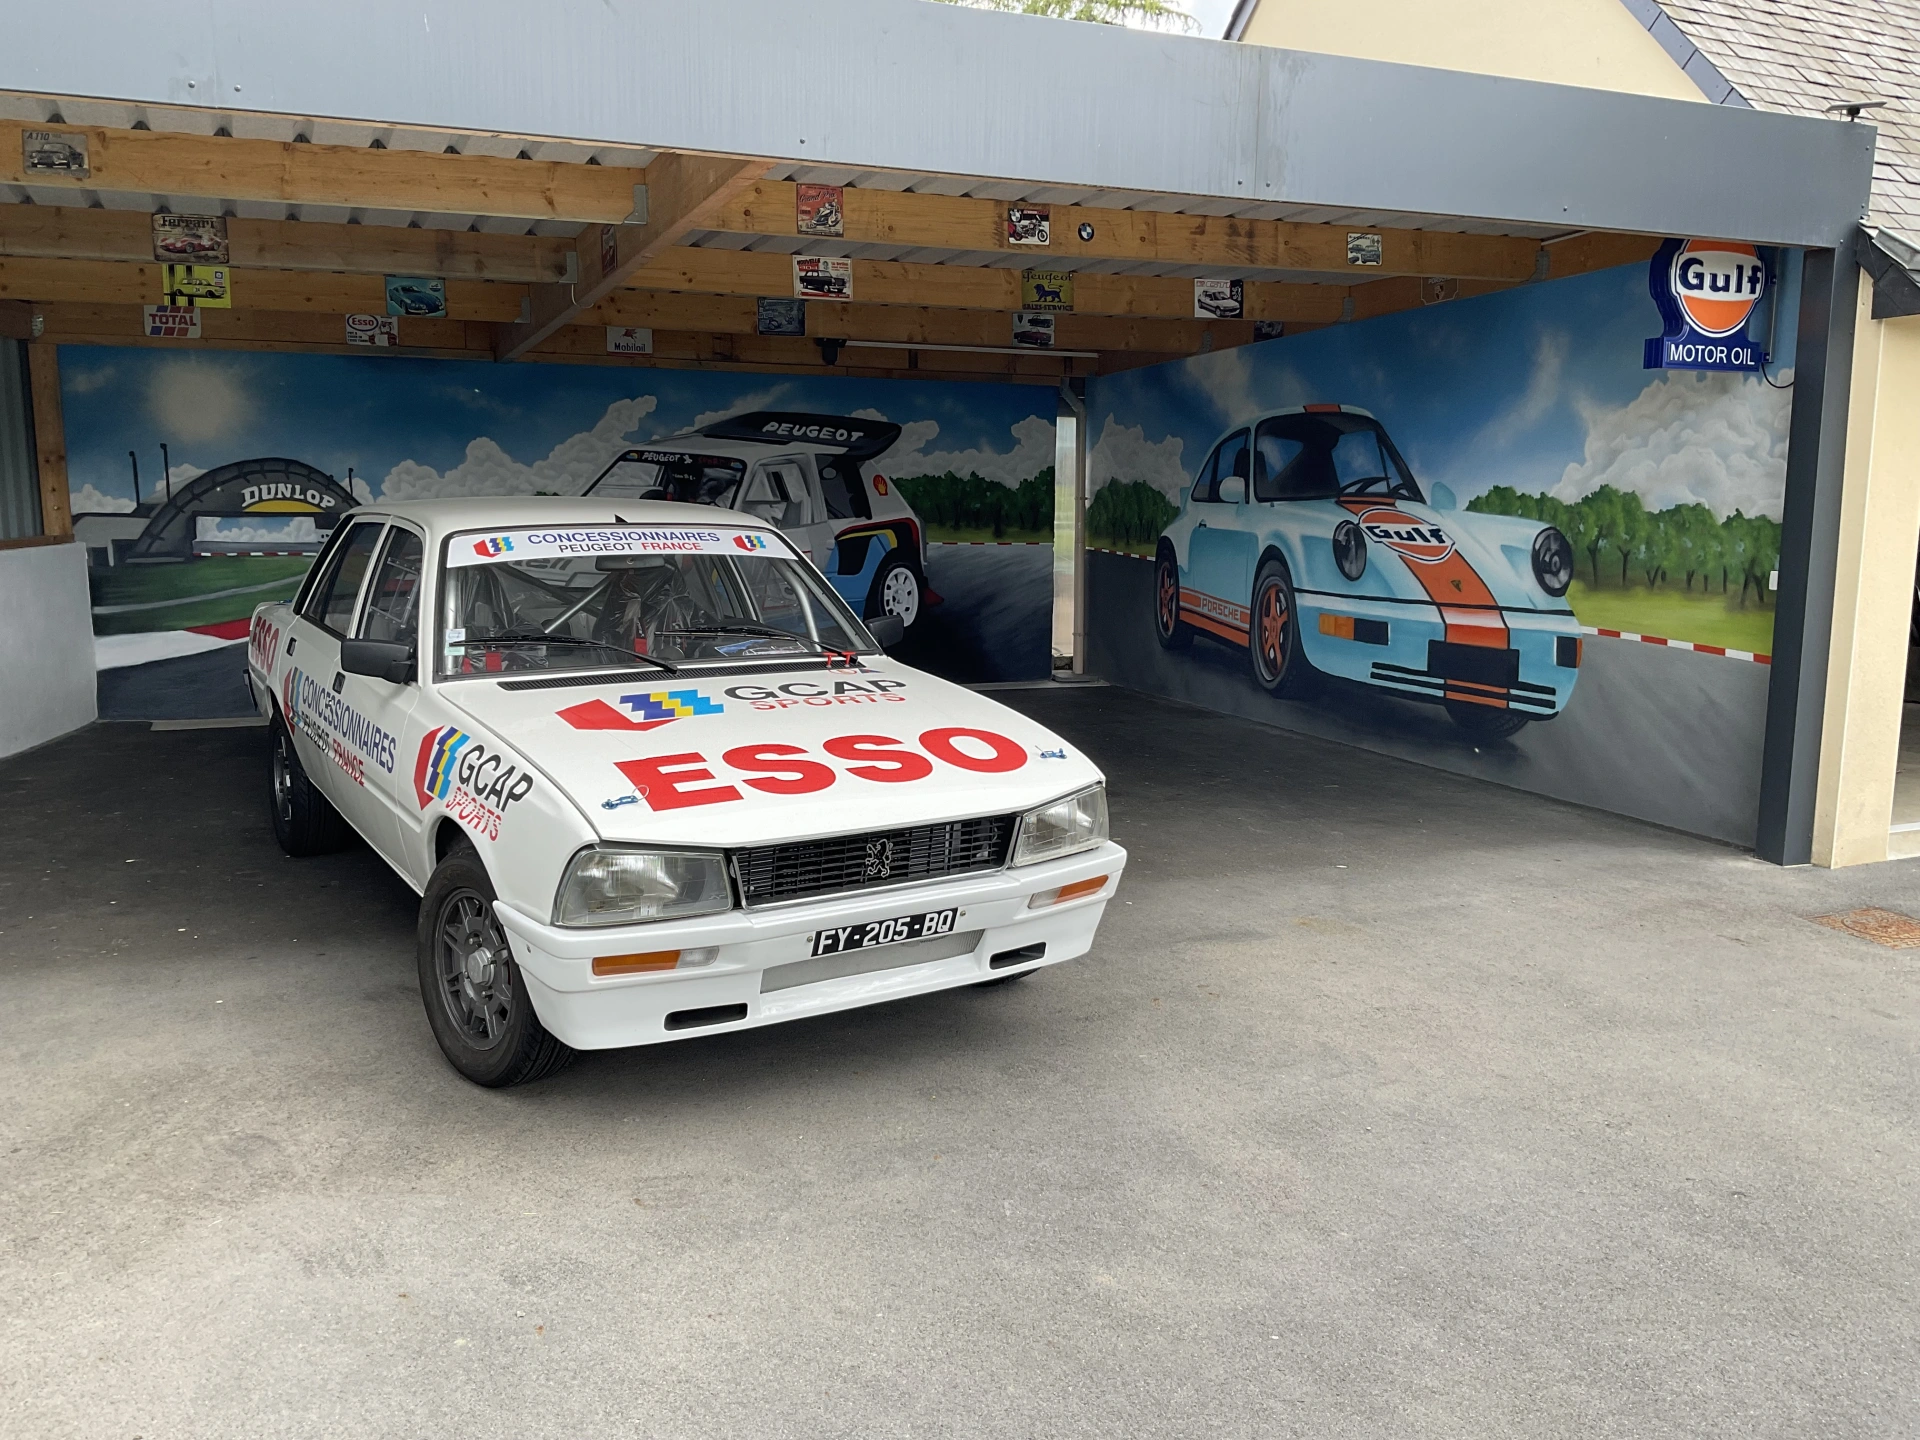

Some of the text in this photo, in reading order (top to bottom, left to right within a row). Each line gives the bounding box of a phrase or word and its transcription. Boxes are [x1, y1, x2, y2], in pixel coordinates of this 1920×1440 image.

[26, 131, 50, 141] A110
[800, 190, 822, 203] Grand
[160, 215, 215, 229] Ferrari
[1022, 270, 1073, 284] Peugeot
[1678, 257, 1762, 295] Gulf
[148, 313, 197, 327] TOTAL
[351, 317, 375, 327] Esso
[614, 342, 646, 353] Mobiloil
[1670, 343, 1756, 366] MOTOR OIL
[761, 421, 865, 442] PEUGEOT
[641, 451, 682, 463] PEUGEOT
[240, 482, 336, 509] DUNLOP
[527, 531, 721, 545] CONCESSIONNAIRES
[1365, 525, 1446, 544] Gulf
[558, 542, 704, 553] PEUGEOT FRANCE
[1201, 597, 1240, 621] PORSCHE
[251, 615, 280, 676] ESSO
[723, 679, 907, 701] GCAP
[749, 692, 907, 711] SPORTS
[301, 675, 397, 774] CONCESSIONNAIRES
[301, 710, 365, 788] PEUGEOT FRANCE
[458, 744, 534, 813] GCAP
[612, 726, 1029, 812] ESSO
[445, 786, 502, 842] SPORTS
[816, 909, 954, 955] FY-205-BQ
